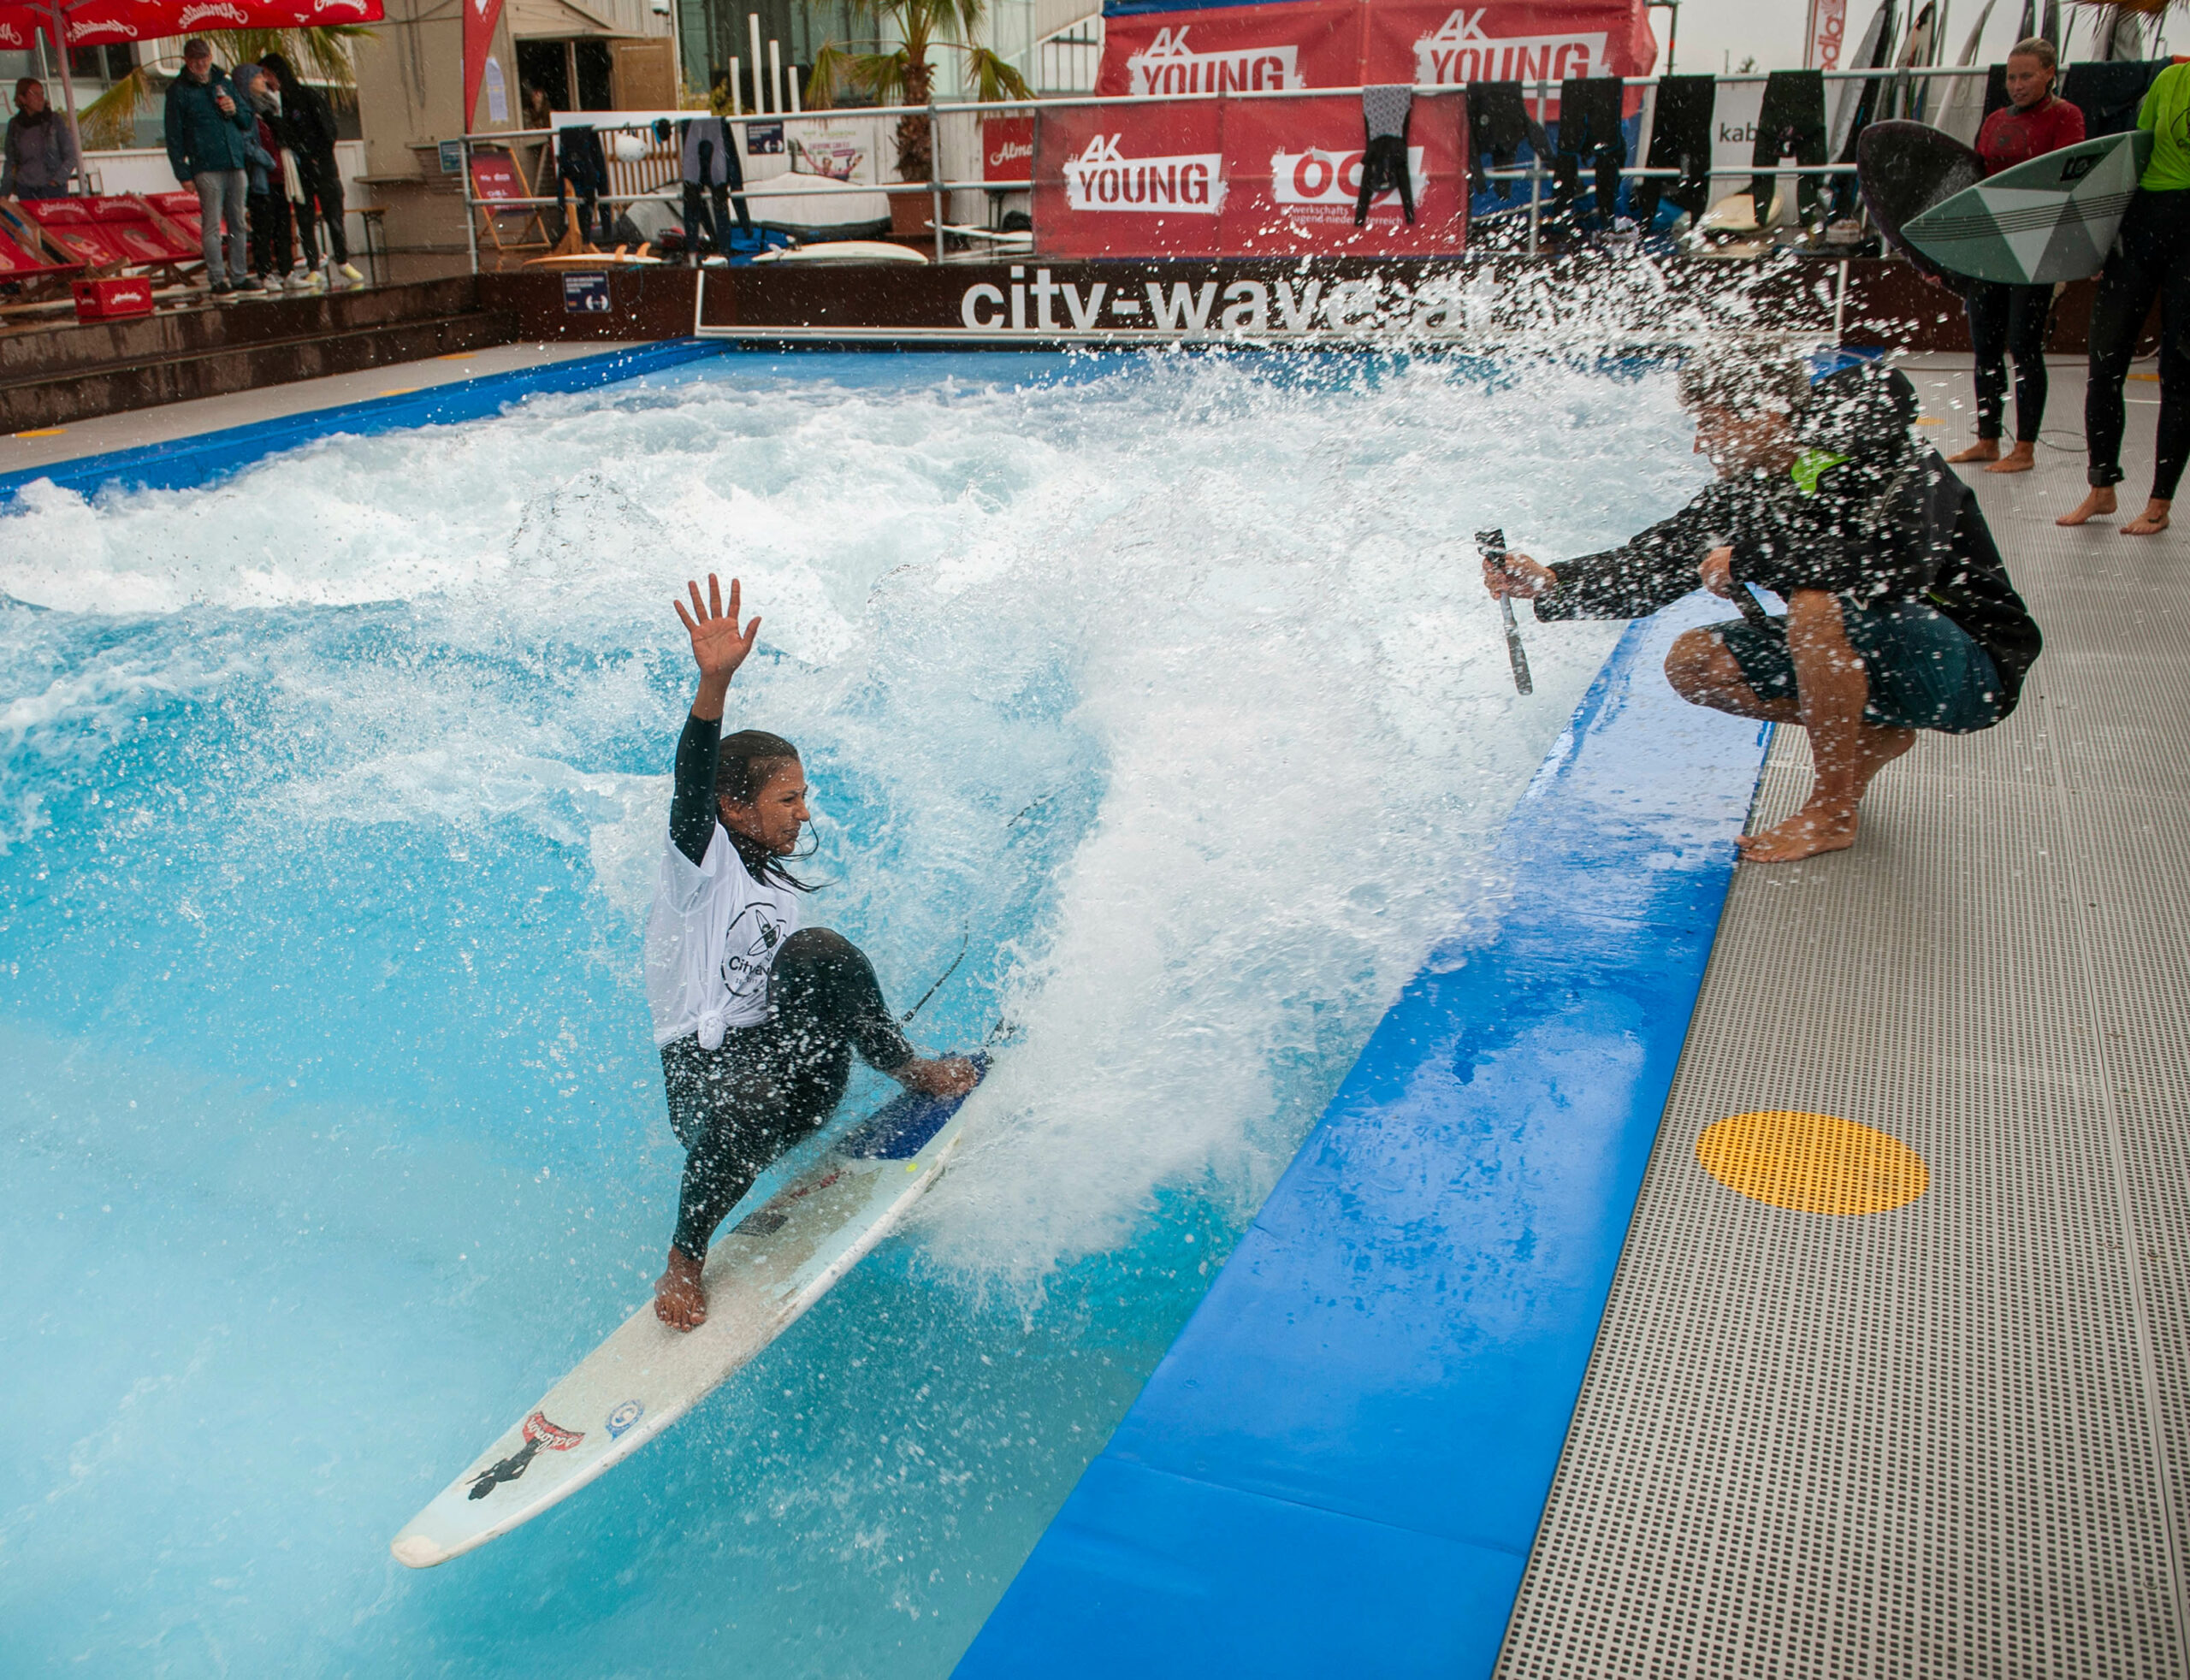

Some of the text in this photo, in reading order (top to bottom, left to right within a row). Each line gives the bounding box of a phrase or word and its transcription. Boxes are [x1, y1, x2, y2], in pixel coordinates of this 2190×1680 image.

[1144, 25, 1195, 57] AK
[1433, 8, 1489, 41] AK
[1142, 56, 1284, 96] YOUNG
[1430, 43, 1590, 85] YOUNG
[1080, 133, 1125, 163] AK
[1079, 163, 1209, 204] YOUNG
[1280, 204, 1349, 216] gwerkschafts
